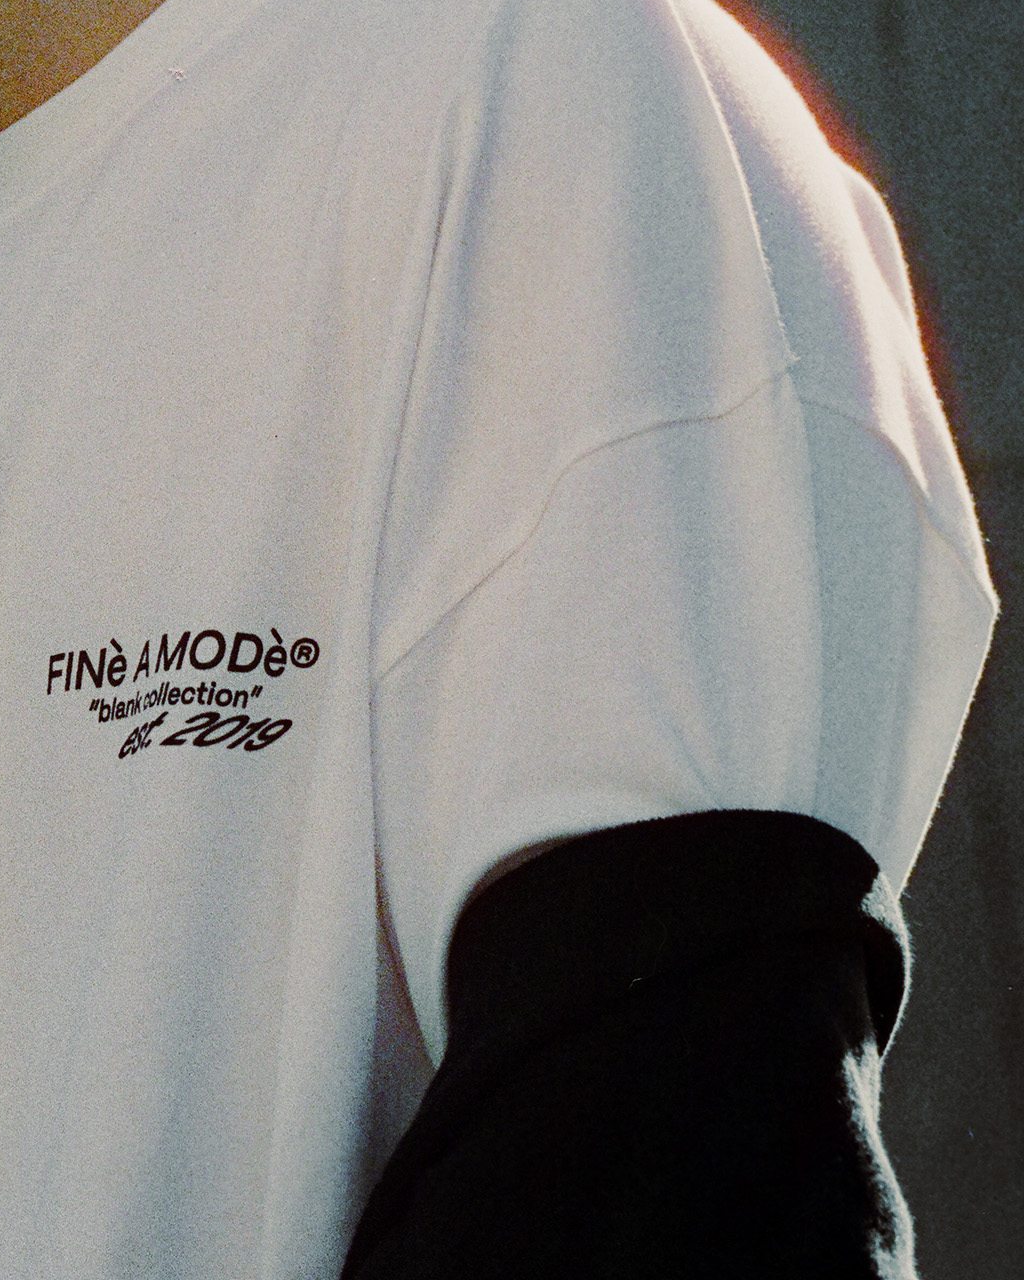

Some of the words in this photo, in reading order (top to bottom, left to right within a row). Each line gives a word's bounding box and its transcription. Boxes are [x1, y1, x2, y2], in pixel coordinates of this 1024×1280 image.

[46, 638, 126, 695] FINè
[133, 640, 151, 683] A
[159, 711, 293, 752] 2019
